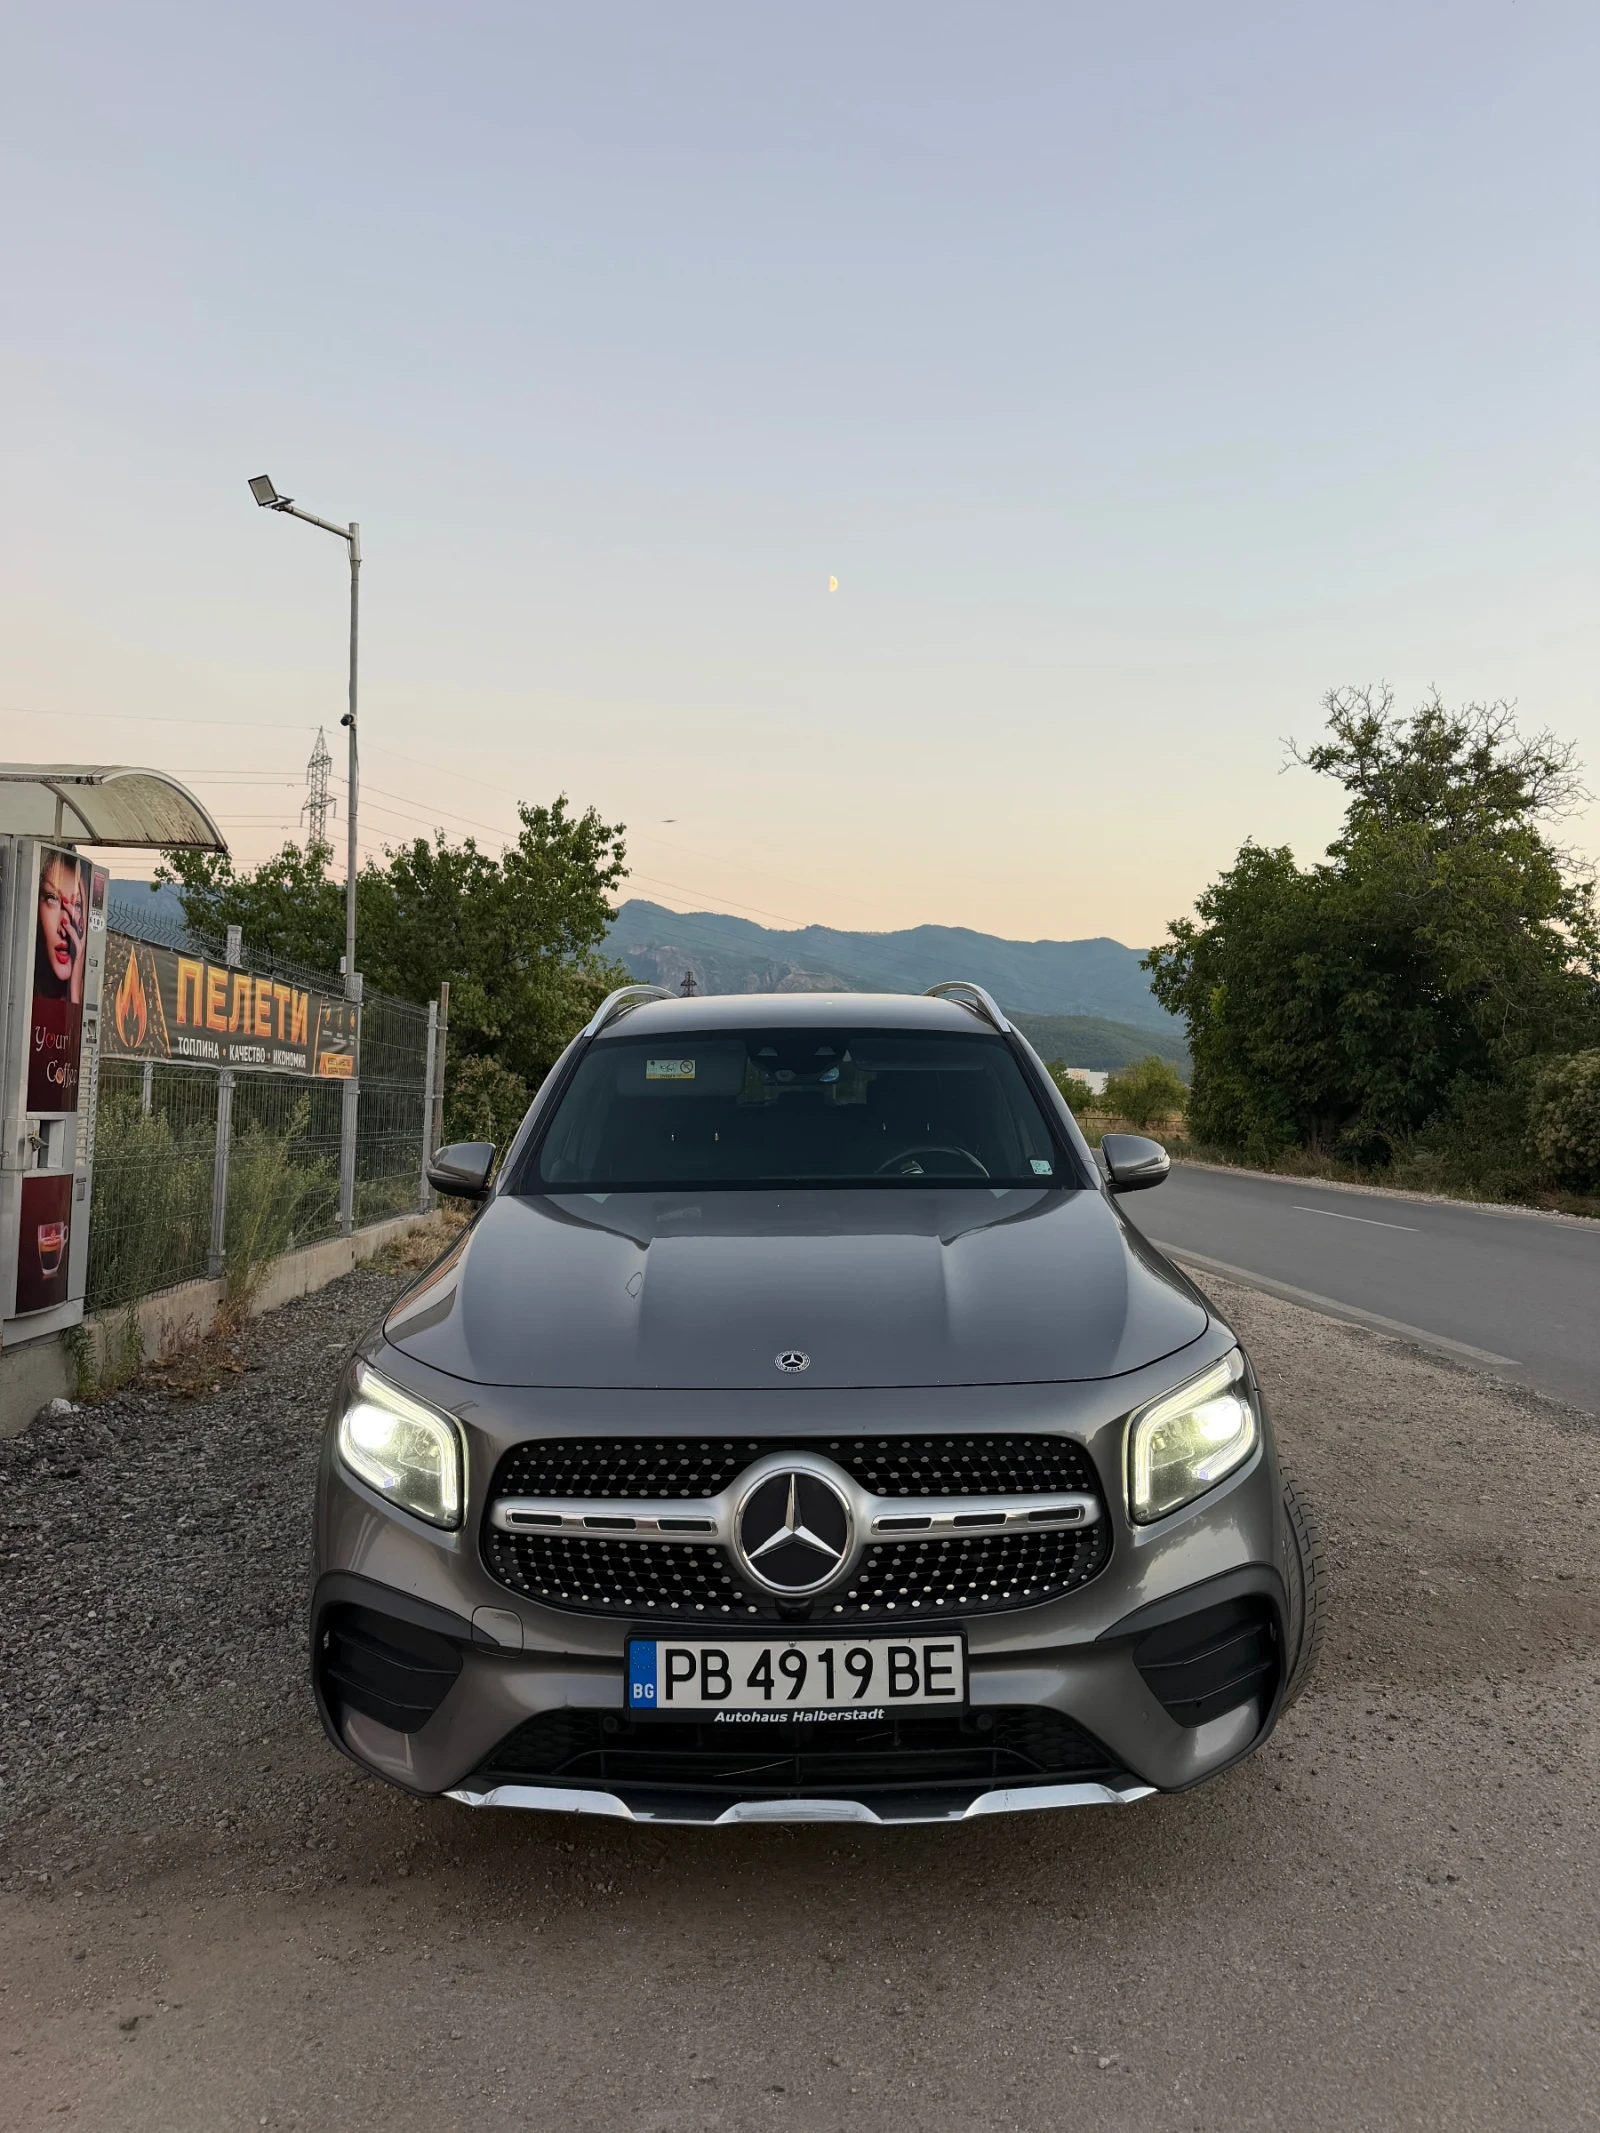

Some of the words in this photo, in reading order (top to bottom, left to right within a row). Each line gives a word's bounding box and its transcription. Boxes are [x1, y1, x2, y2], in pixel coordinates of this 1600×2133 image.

[176, 956, 310, 1047] ПЕЛЕТИ
[177, 1036, 220, 1060] ТОПЛИНА
[229, 1044, 266, 1064] КАЧЕСТВО
[272, 1049, 307, 1069] ИКОНОМИЯ
[665, 1648, 732, 1701] PB
[746, 1647, 874, 1700] 4919
[887, 1644, 957, 1698] BE
[633, 1683, 655, 1699] BG
[713, 1711, 789, 1723] Autohaus
[792, 1708, 885, 1722] Halberstadt
